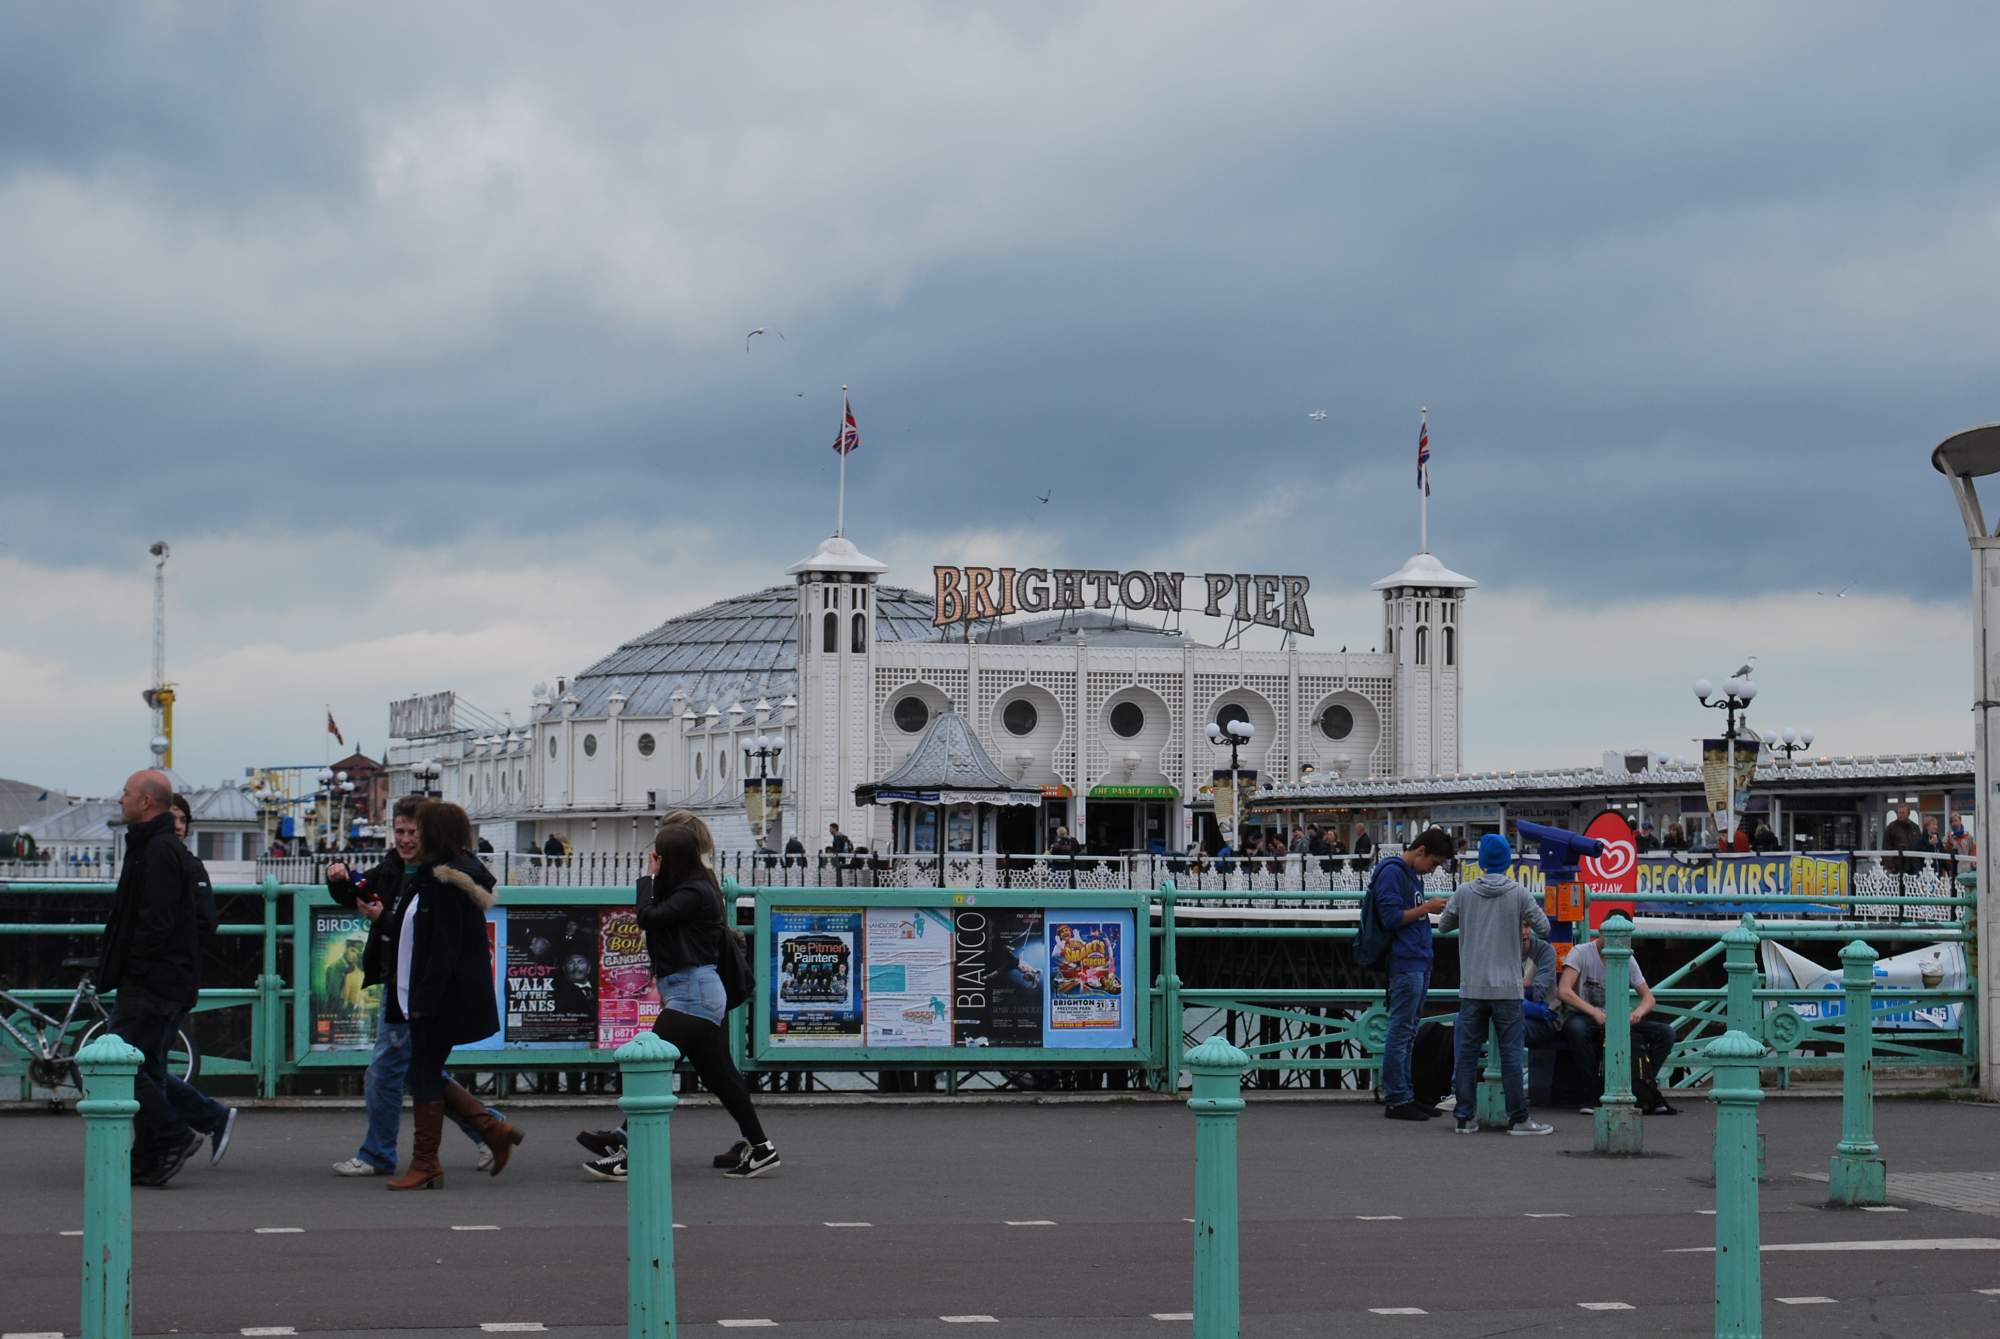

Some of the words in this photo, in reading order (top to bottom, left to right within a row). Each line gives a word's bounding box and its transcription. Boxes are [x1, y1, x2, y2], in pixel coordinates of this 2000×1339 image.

[933, 566, 1184, 626] BRIGHTON
[1204, 573, 1314, 636] PIER
[1094, 787, 1107, 795] THE
[1112, 787, 1140, 795] PALACE
[1145, 787, 1153, 795] OF
[1506, 808, 1570, 817] SHELLFISH
[1637, 860, 1785, 896] DECKCHAIRS!
[1791, 855, 1849, 909] FREE!
[785, 942, 807, 953] The
[808, 942, 846, 953] Pitmen
[794, 953, 839, 963] Painters
[957, 912, 986, 1008] BIANCO
[508, 966, 555, 977] GHOST
[508, 978, 554, 991] WALK
[509, 1000, 555, 1012] LANES
